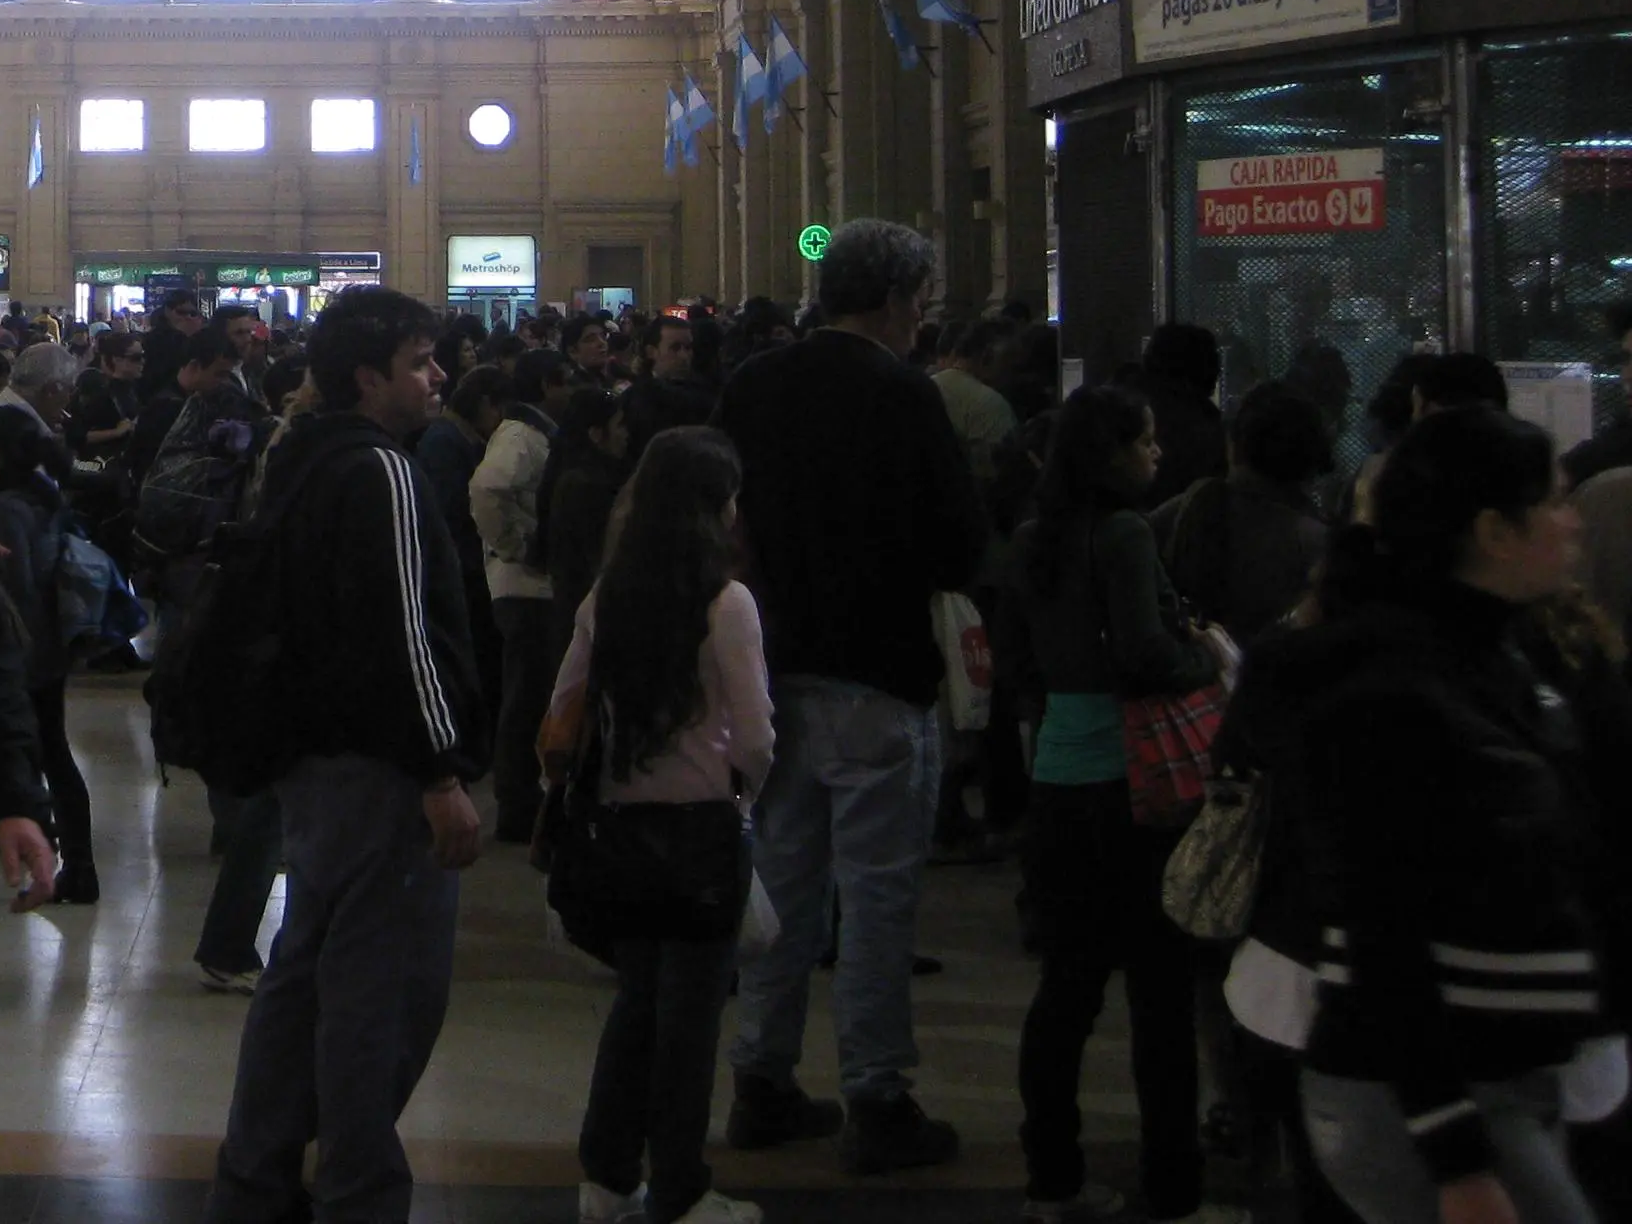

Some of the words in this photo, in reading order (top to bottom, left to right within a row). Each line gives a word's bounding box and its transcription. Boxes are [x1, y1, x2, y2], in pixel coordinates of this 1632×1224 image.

[1229, 160, 1268, 186] CAJA
[1272, 156, 1339, 183] RAPIDA
[1204, 197, 1248, 234] Pago
[1253, 194, 1318, 225] Exacto
